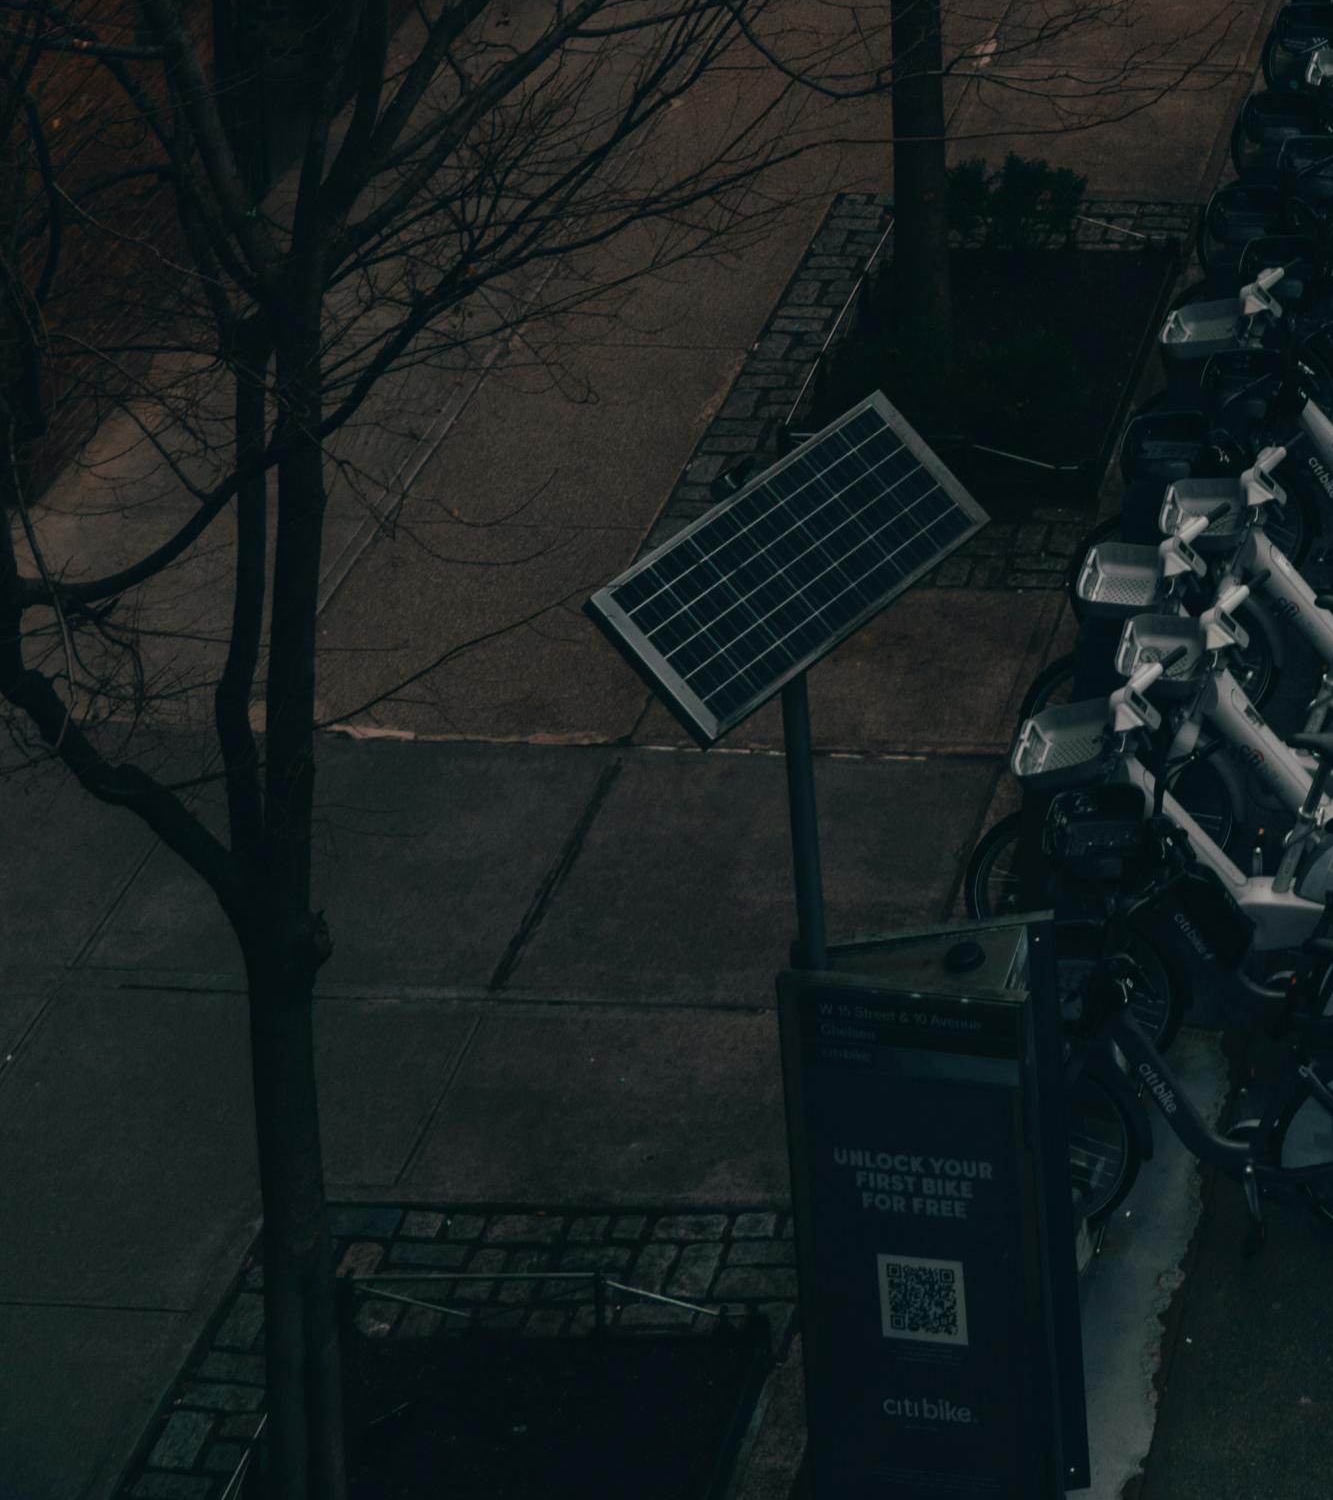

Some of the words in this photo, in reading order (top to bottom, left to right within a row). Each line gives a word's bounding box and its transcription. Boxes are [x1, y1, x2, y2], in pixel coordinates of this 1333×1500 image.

[820, 1023, 876, 1040] Chelsea
[852, 1005, 895, 1022] Street
[899, 1011, 909, 1023] &
[913, 1012, 927, 1025] 10
[930, 1014, 982, 1031] Avenue
[833, 1147, 925, 1174] UNLOCK
[928, 1156, 993, 1180] YOUR
[856, 1169, 917, 1193] FIRST
[921, 1177, 974, 1199] BIKE
[862, 1191, 907, 1213] FOR
[912, 1197, 968, 1220] FREE
